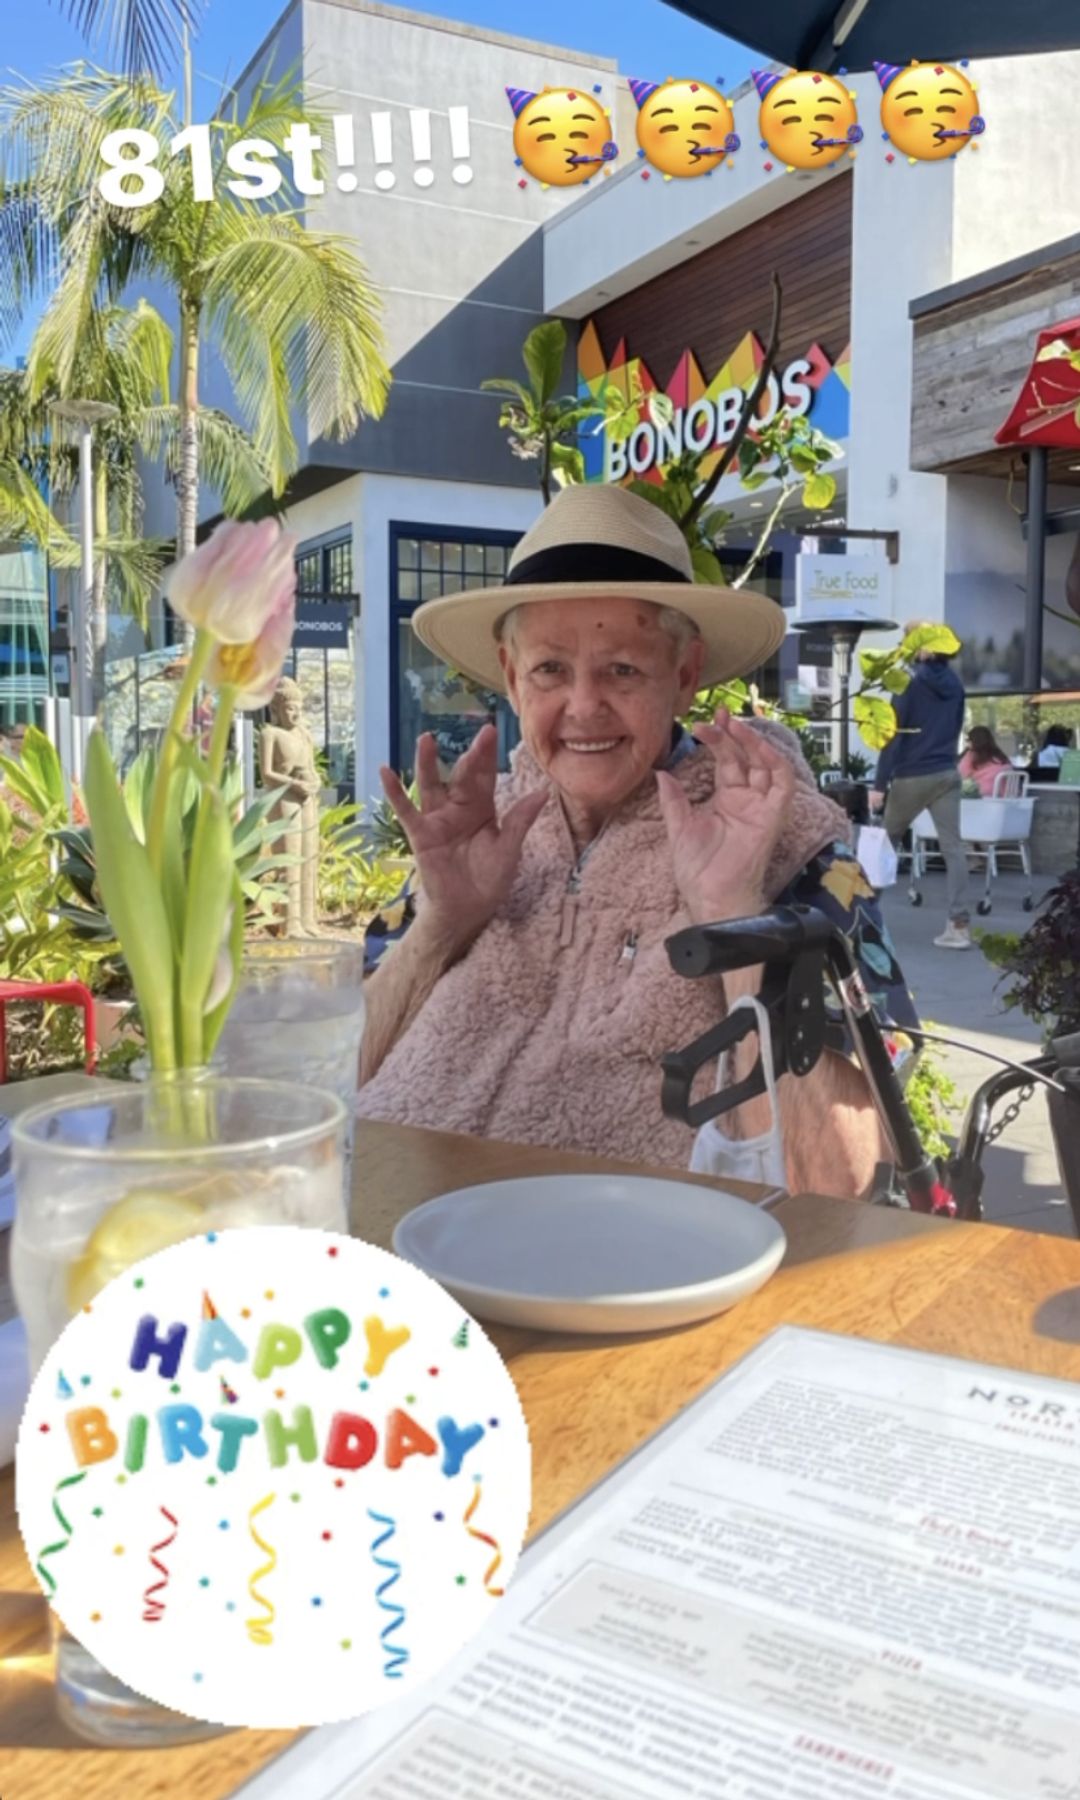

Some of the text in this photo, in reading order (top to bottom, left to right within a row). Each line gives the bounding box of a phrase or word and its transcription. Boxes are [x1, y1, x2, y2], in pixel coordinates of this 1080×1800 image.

[608, 360, 812, 482] BONOBOS
[814, 570, 878, 589] True Food
[967, 1387, 1080, 1415] NOR
